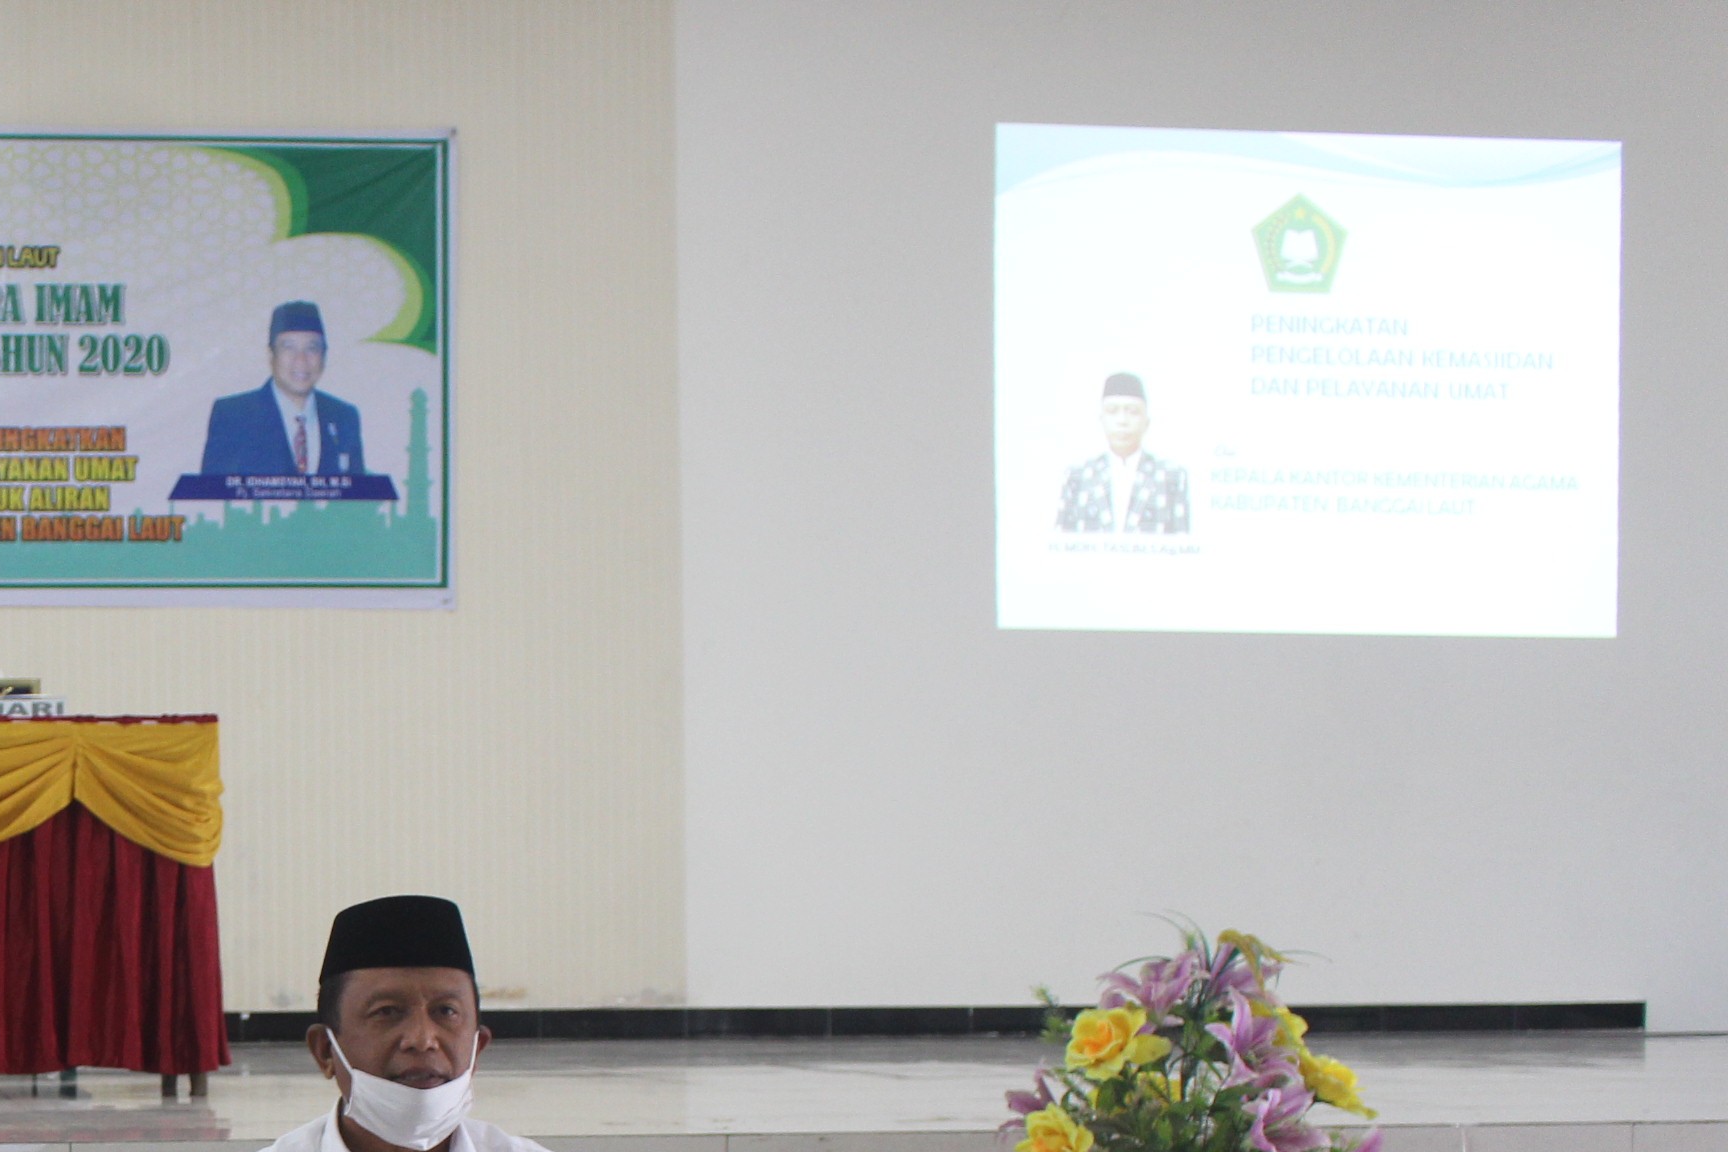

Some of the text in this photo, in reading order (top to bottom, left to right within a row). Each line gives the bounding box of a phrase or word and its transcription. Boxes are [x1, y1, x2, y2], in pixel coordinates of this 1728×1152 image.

[7, 246, 60, 268] LAUT
[33, 283, 125, 325] IMAM
[1251, 313, 1409, 336] PENINGKATAN
[78, 333, 170, 376] 2020
[1251, 344, 1414, 366] PENGELOLAAN
[1251, 376, 1510, 401] DAN PELAYANAN UMAT
[74, 455, 139, 482] UMAT
[29, 485, 110, 511] ALIRAN
[23, 516, 124, 541] BANGGAI
[127, 515, 185, 541] LAUT
